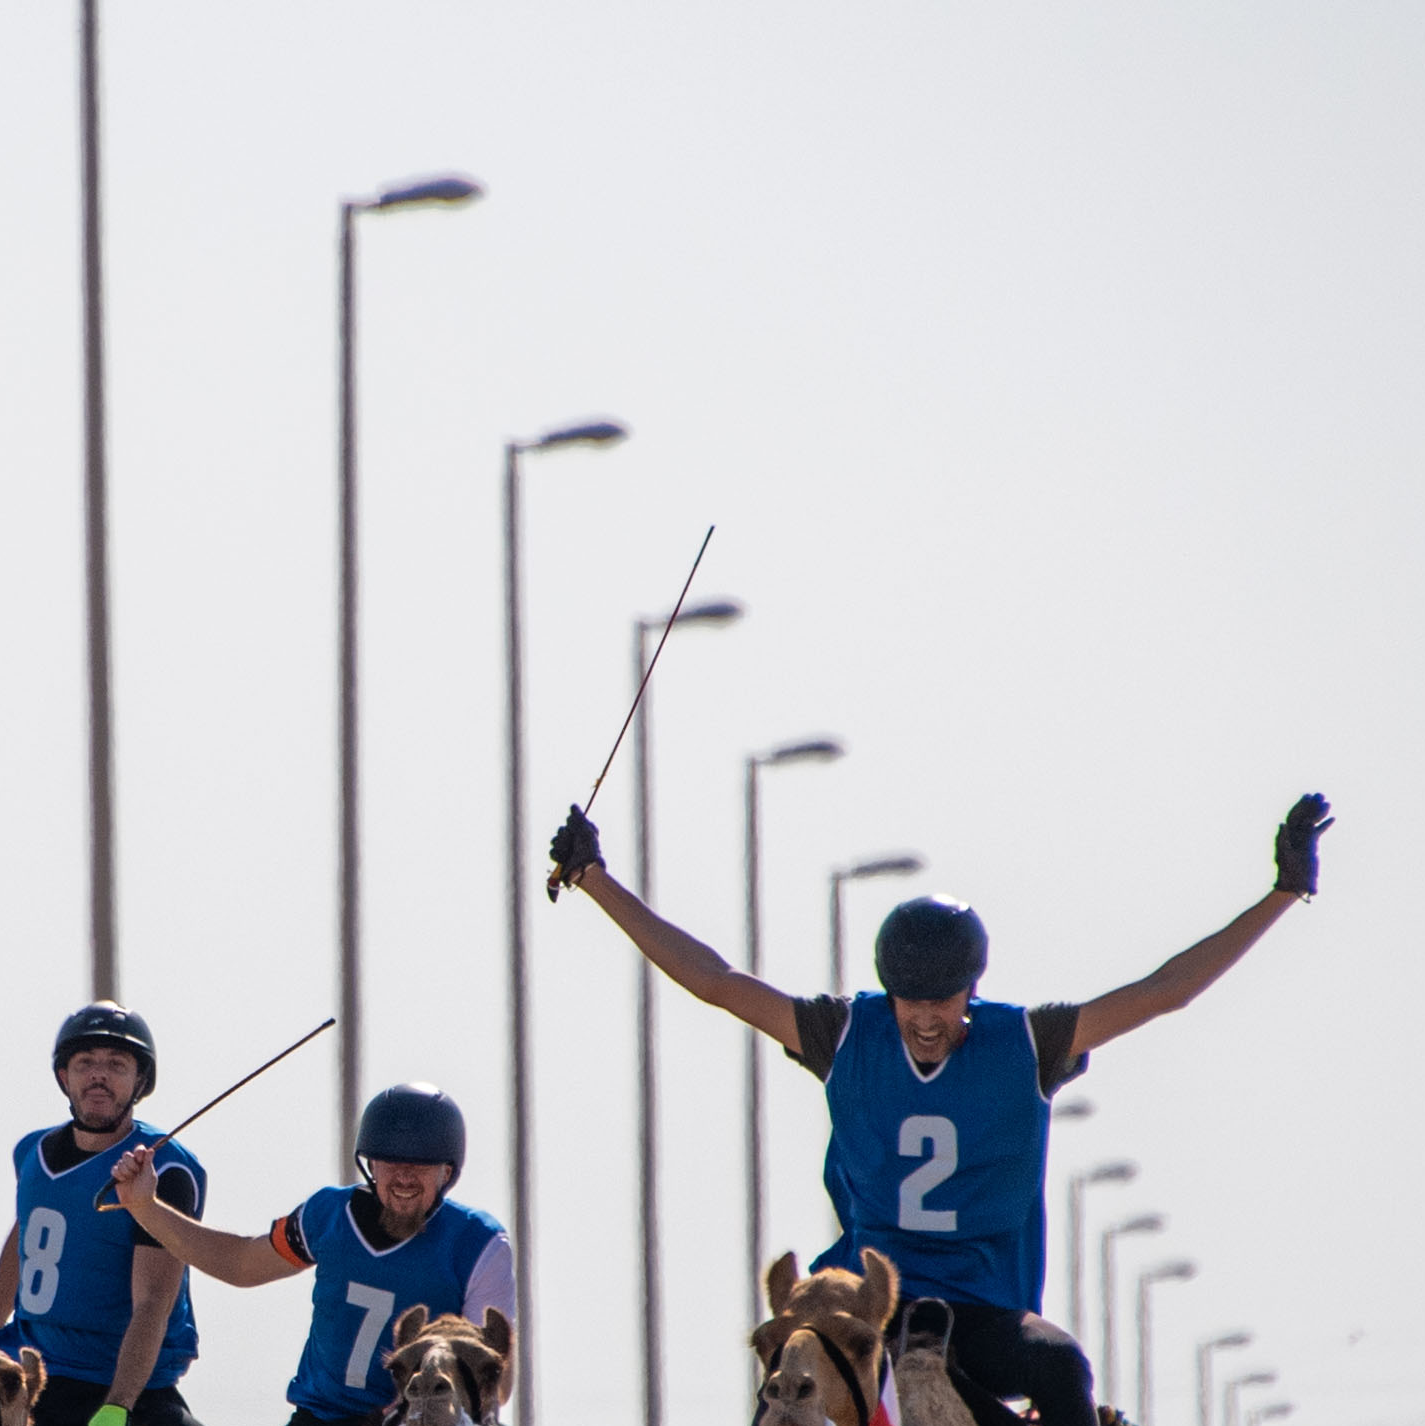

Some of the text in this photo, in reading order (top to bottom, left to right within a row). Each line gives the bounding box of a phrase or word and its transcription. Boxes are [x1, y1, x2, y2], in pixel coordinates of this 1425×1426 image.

[898, 1115, 958, 1232] 2
[18, 1207, 67, 1316] 8
[345, 1281, 396, 1389] 7
